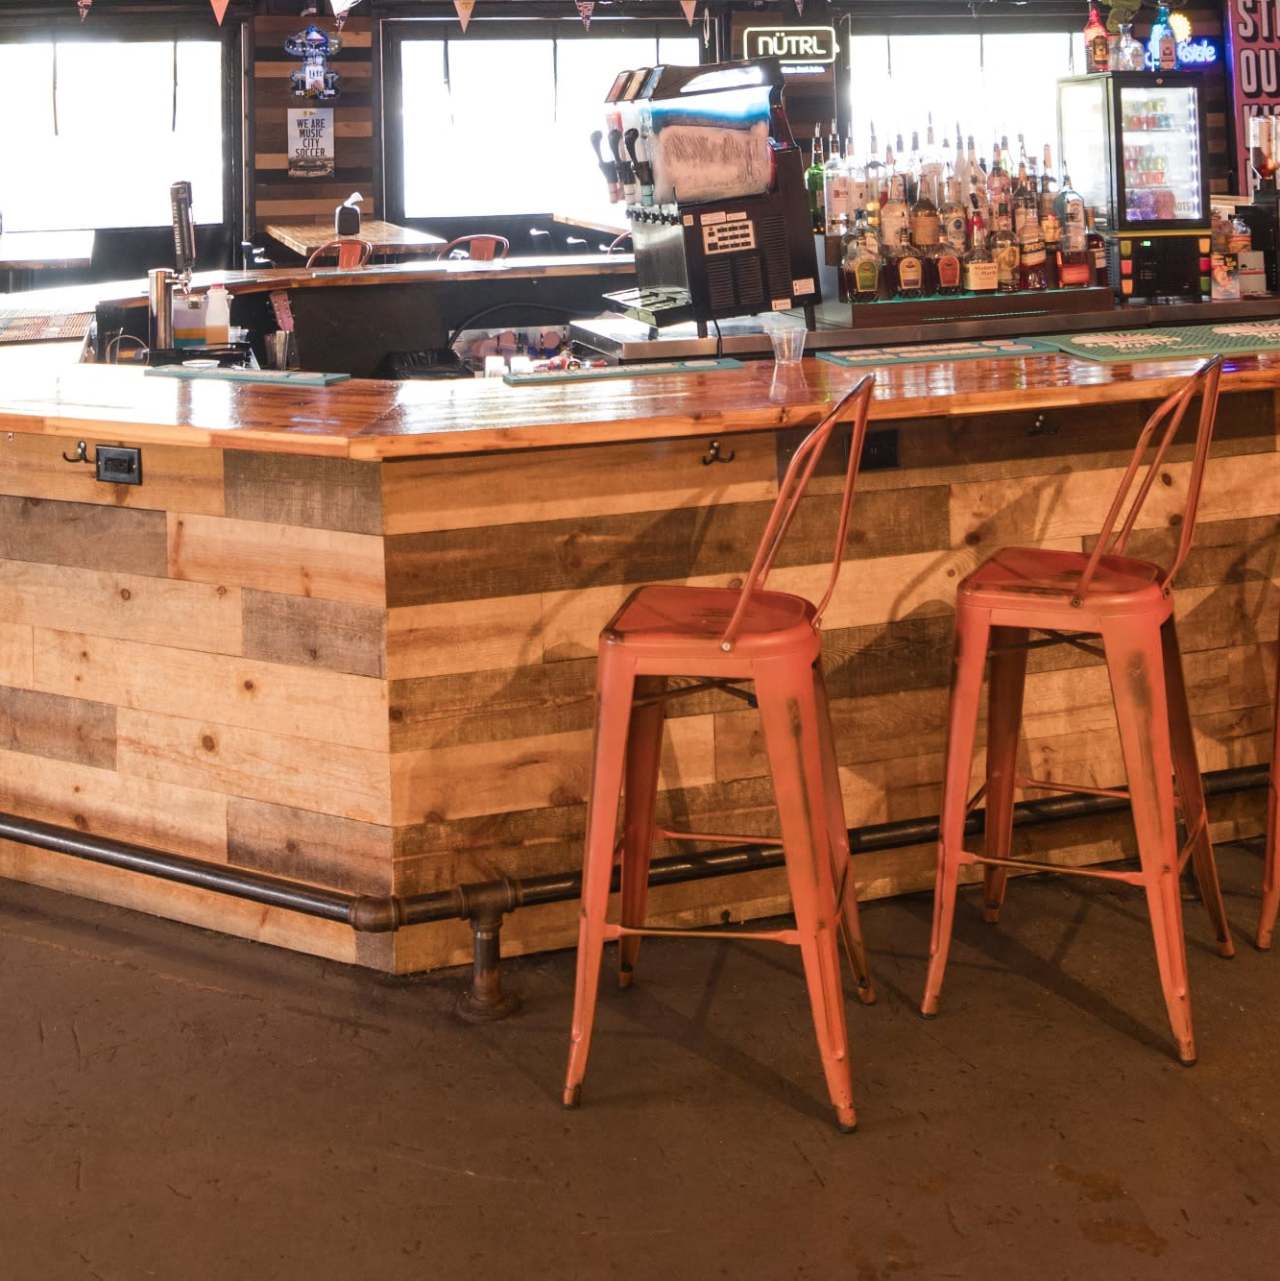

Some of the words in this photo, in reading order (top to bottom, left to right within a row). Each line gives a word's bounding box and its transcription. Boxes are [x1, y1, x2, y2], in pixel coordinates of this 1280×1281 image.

[296, 118, 310, 129] WE
[310, 118, 326, 129] ARE
[298, 128, 324, 138] MUSIC
[302, 138, 321, 148] CITY
[295, 147, 326, 158] SOCCER
